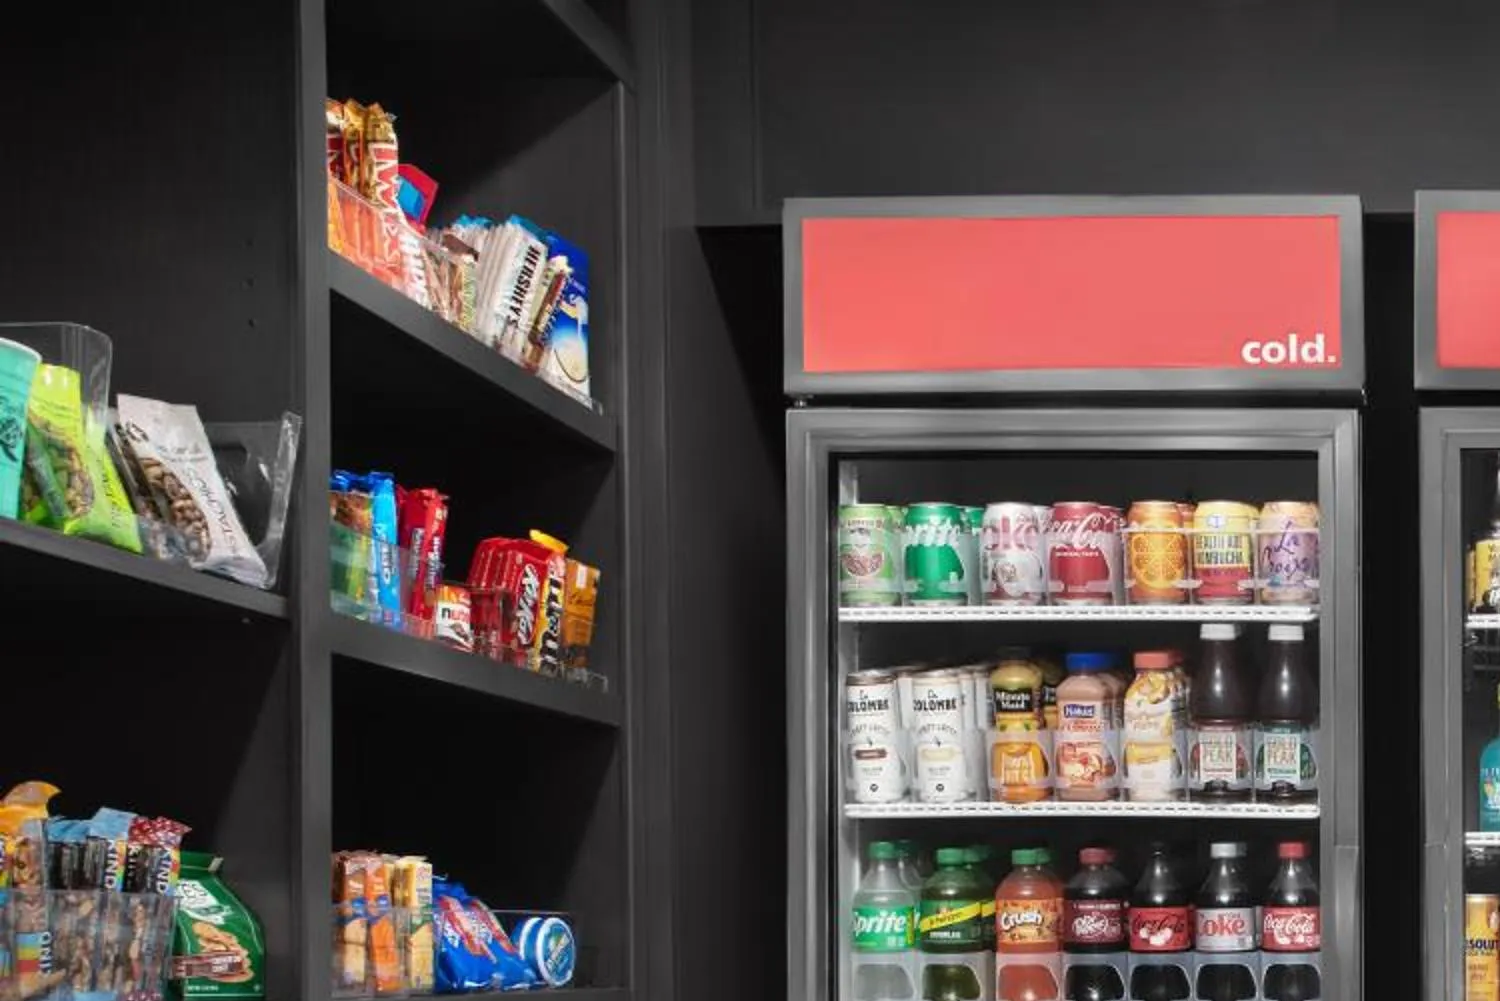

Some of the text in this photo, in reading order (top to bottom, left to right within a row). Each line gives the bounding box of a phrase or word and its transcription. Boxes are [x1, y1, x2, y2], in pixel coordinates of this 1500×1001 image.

[508, 245, 541, 328] HERSHEY'S
[1241, 333, 1337, 364] cold.
[104, 838, 119, 890] KIND
[155, 846, 174, 896] KIND
[1002, 911, 1043, 930] Crush
